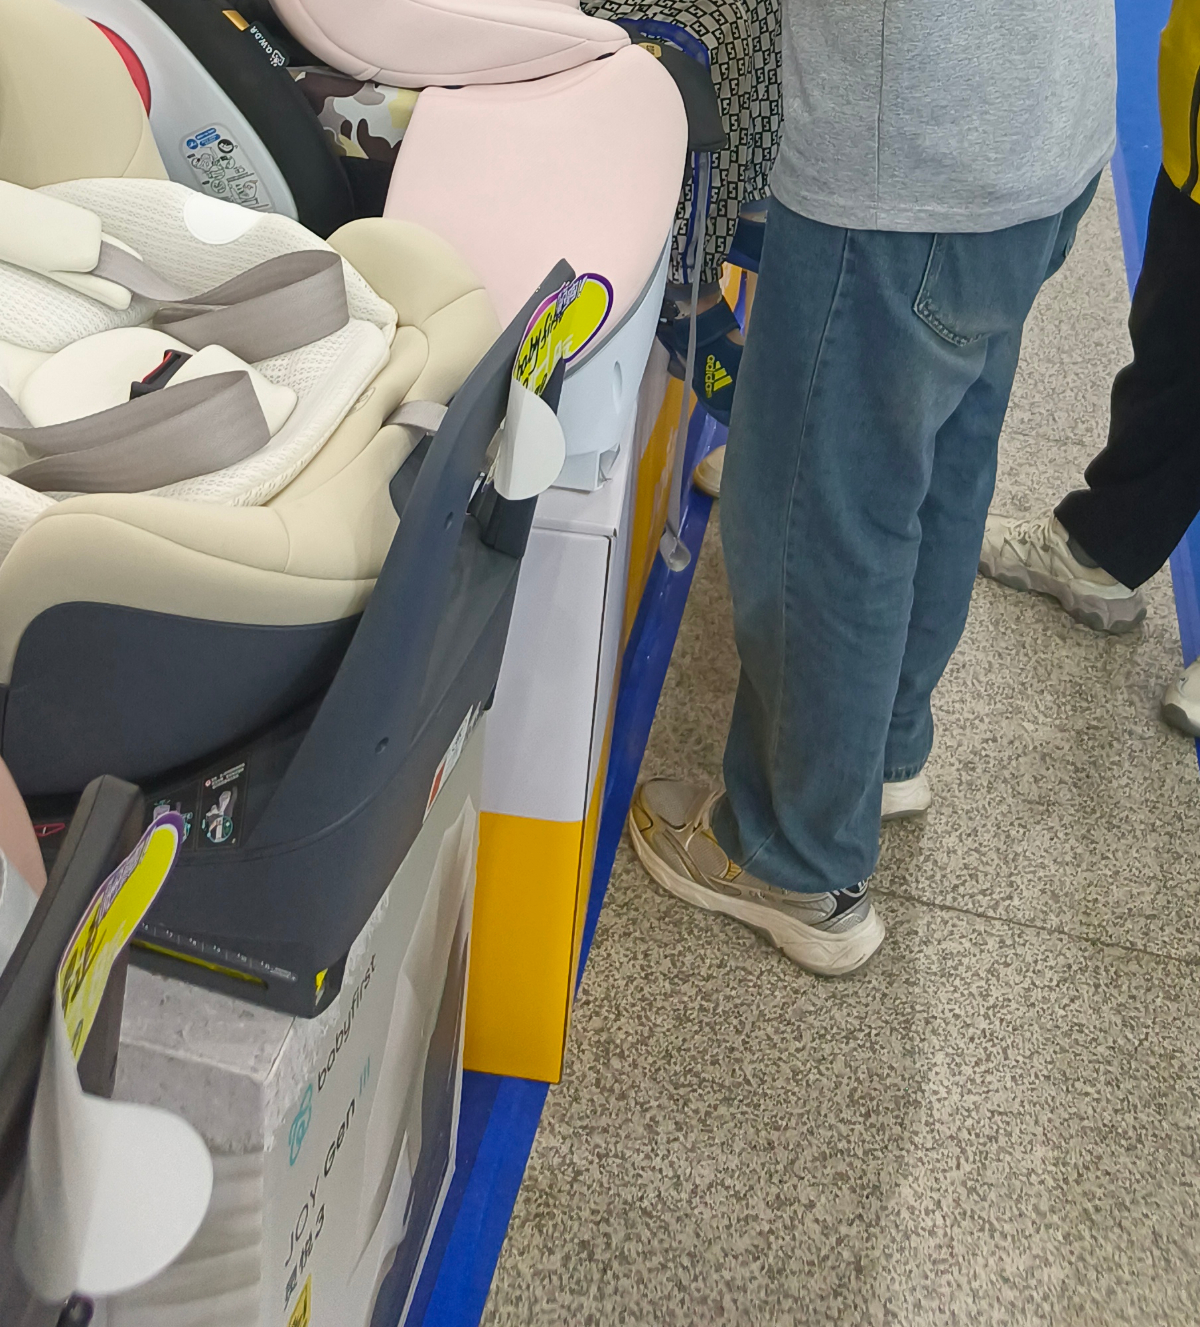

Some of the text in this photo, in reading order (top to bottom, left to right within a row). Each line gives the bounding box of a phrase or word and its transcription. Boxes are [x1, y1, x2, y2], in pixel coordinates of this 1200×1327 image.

[705, 354, 716, 399] adidas
[317, 952, 377, 1094] babyfirst
[284, 1173, 320, 1268] JOY
[323, 1097, 356, 1178] Gen
